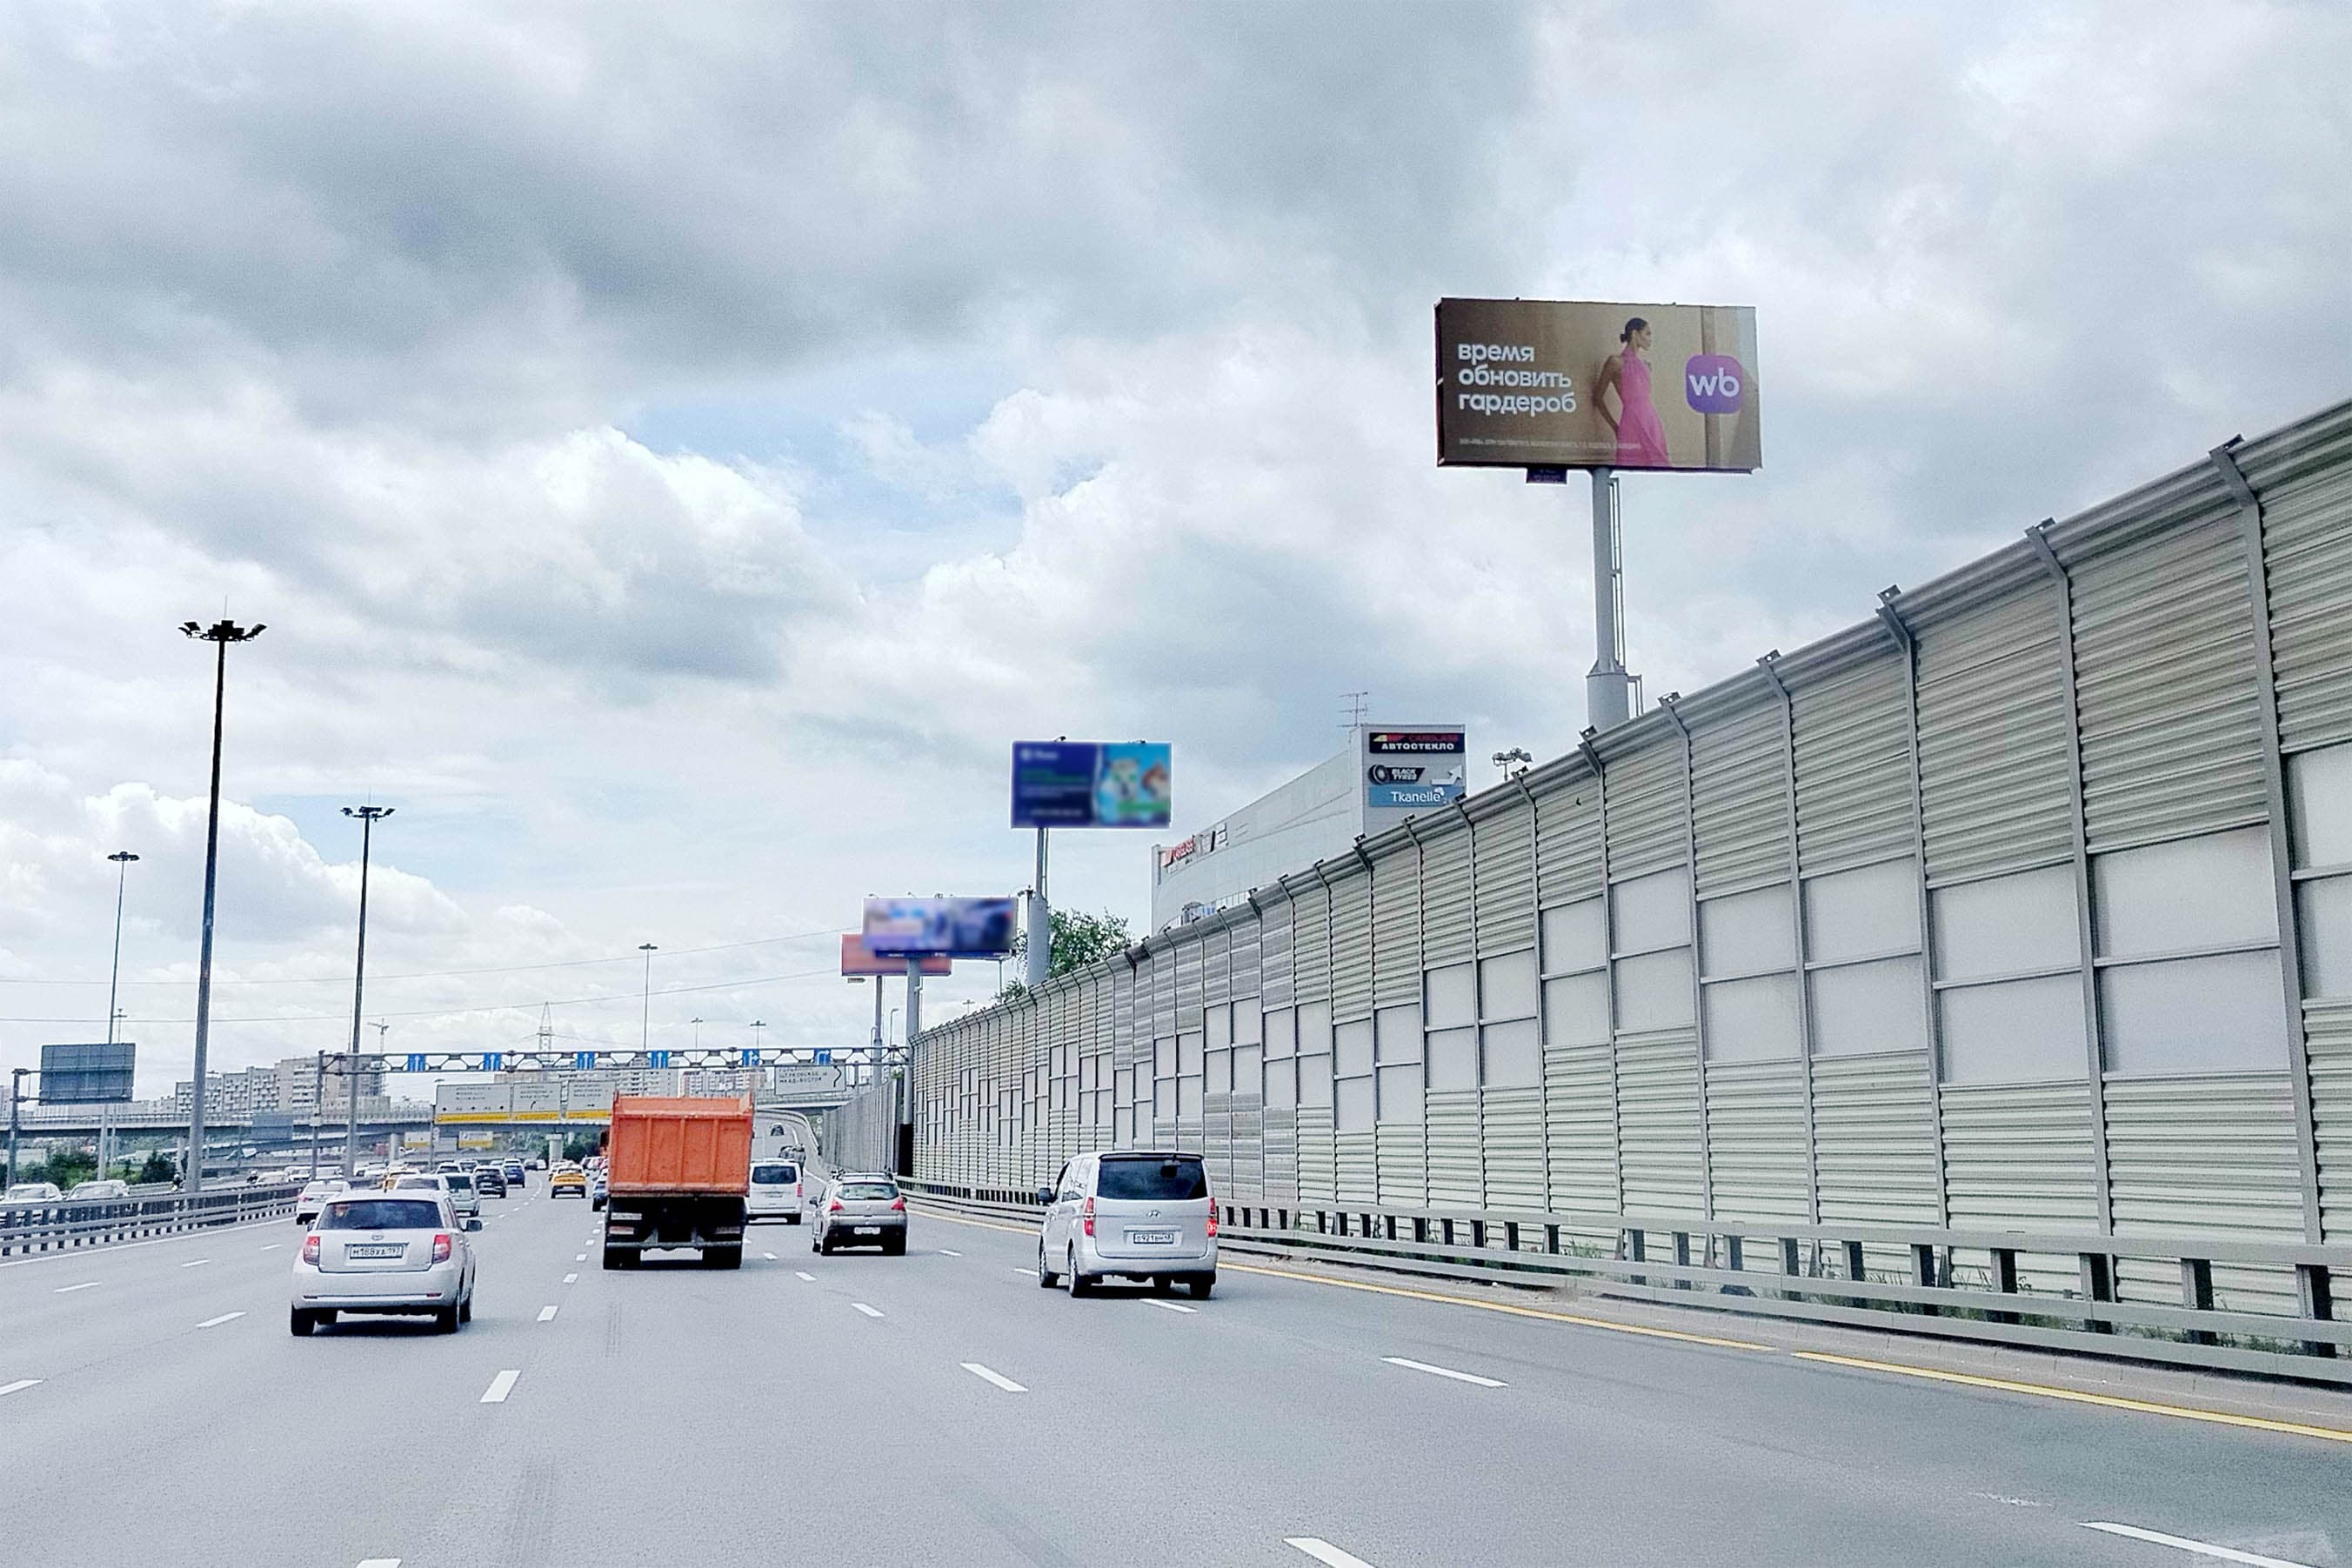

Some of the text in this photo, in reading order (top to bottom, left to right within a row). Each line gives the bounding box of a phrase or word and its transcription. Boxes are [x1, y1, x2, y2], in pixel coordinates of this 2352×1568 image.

[1458, 344, 1534, 366] время
[1458, 364, 1573, 388] обновить
[1688, 367, 1740, 397] wb
[1458, 392, 1577, 417] гардероб
[1390, 791, 1441, 802] Tkanelle
